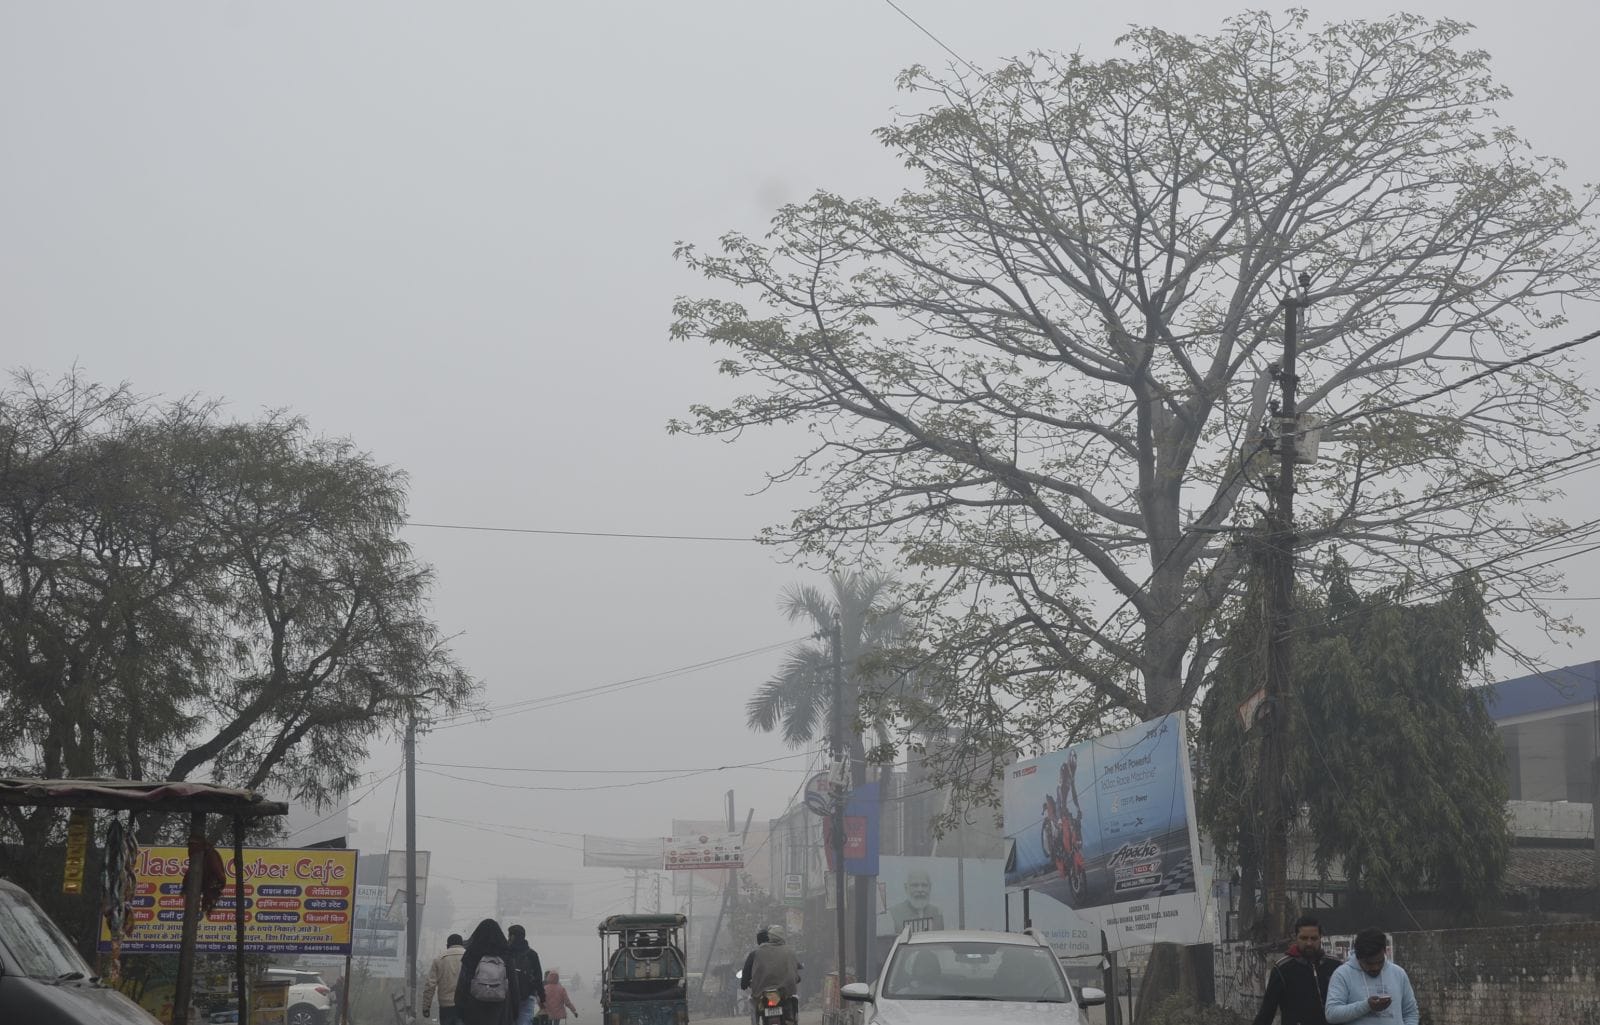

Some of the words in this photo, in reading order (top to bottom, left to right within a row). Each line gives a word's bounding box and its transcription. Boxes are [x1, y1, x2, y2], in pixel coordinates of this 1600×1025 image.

[1108, 840, 1159, 867] Apache
[226, 857, 290, 882] Cyber
[295, 857, 346, 885] Cafe
[1051, 929, 1070, 938] with
[1072, 930, 1087, 938] E20
[1070, 941, 1090, 951] India
